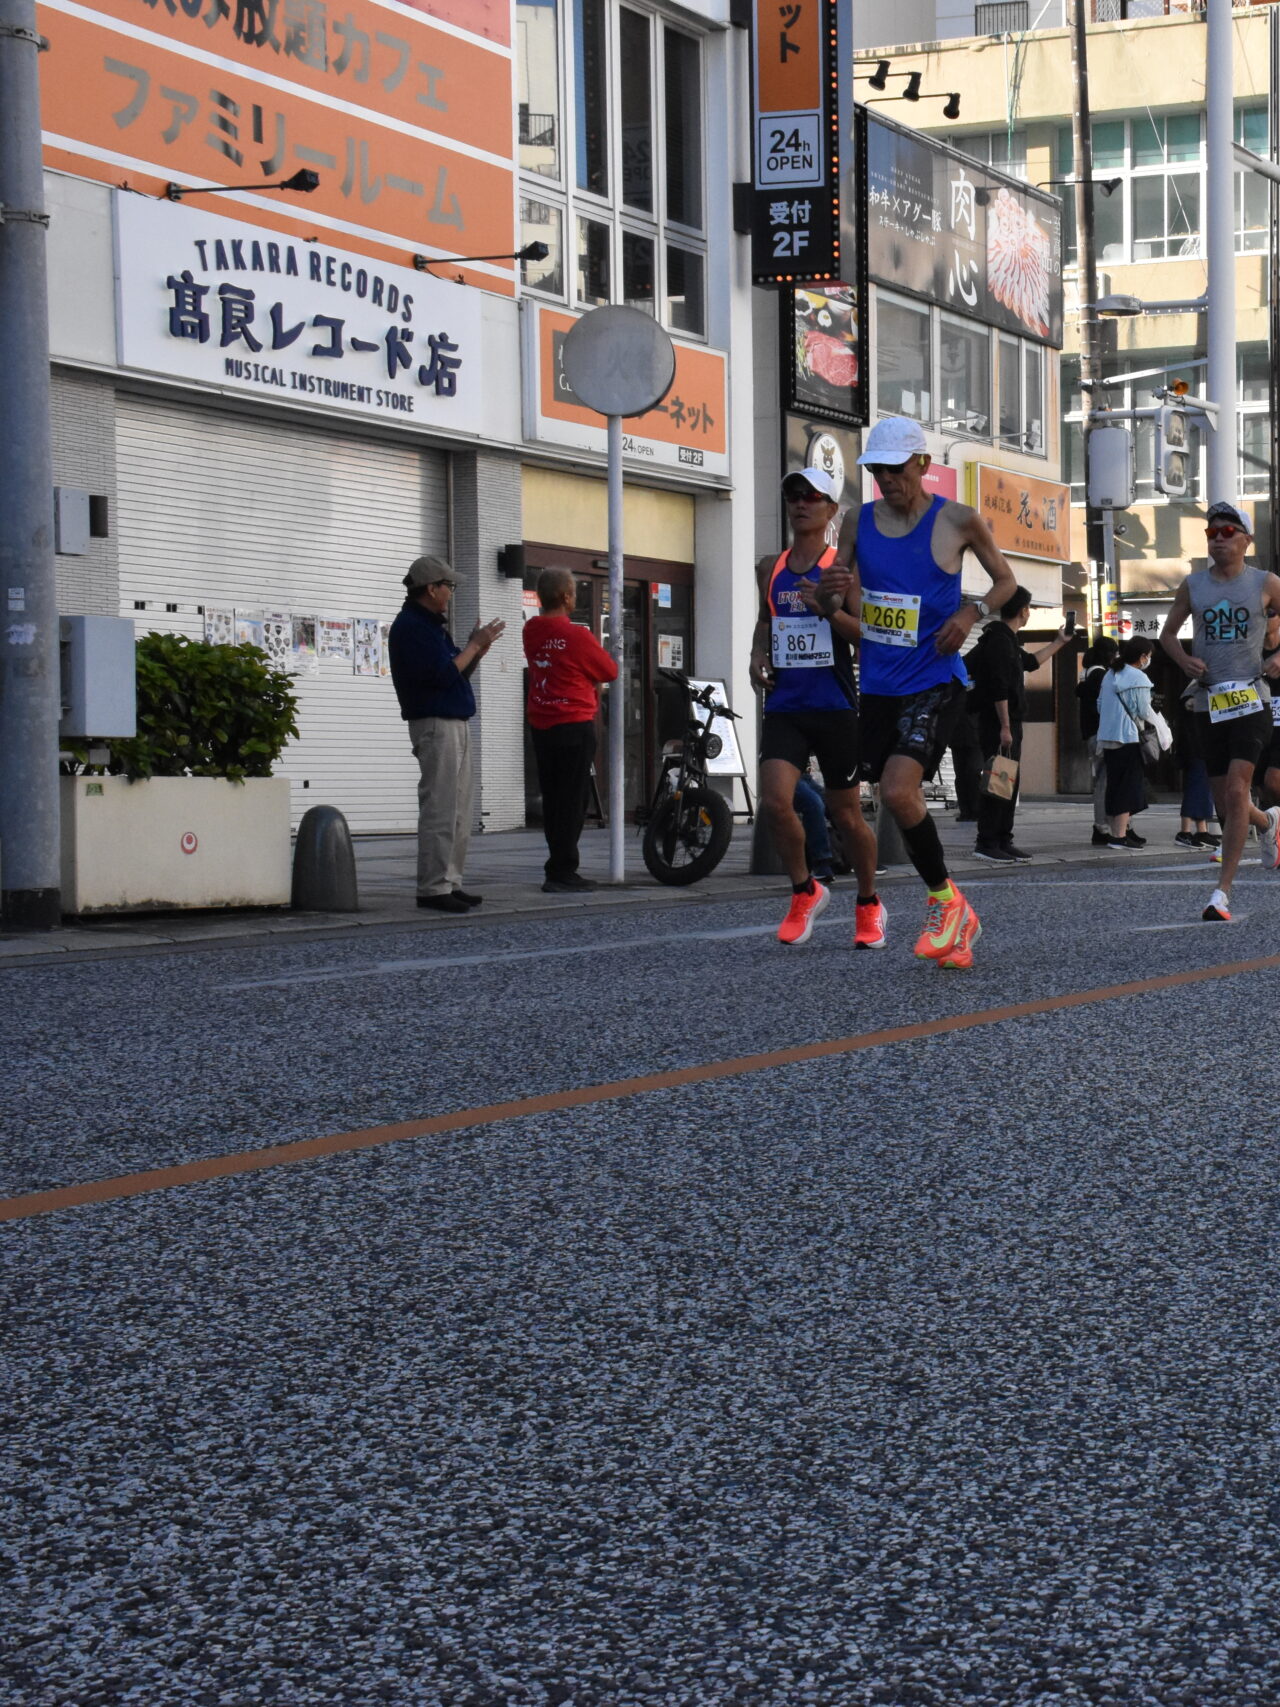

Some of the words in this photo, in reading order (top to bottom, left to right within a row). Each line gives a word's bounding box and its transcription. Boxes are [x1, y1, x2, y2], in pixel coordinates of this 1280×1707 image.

[142, 0, 449, 113] 放題カフェ
[103, 56, 466, 232] ファミリールーム
[769, 129, 811, 154] 24h
[766, 154, 814, 171] OPEN
[769, 200, 812, 226] 受付
[772, 230, 810, 258] 2F
[949, 168, 979, 306] 肉心
[194, 238, 299, 277] TAKARA
[309, 250, 414, 323] RECORDS
[225, 357, 286, 388] MUSICAL
[290, 371, 373, 405] INSTRUMENT
[376, 391, 415, 413] STORE
[640, 396, 715, 434] ーネット
[637, 444, 655, 456] OPEN
[679, 448, 692, 462] 受付
[692, 451, 703, 465] 2F
[873, 606, 906, 629] 266
[1202, 607, 1250, 624] ONO
[772, 633, 780, 651] B
[787, 633, 816, 651] 867
[1205, 623, 1248, 640] REN
[1211, 697, 1219, 711] A
[1224, 690, 1250, 708] 165
